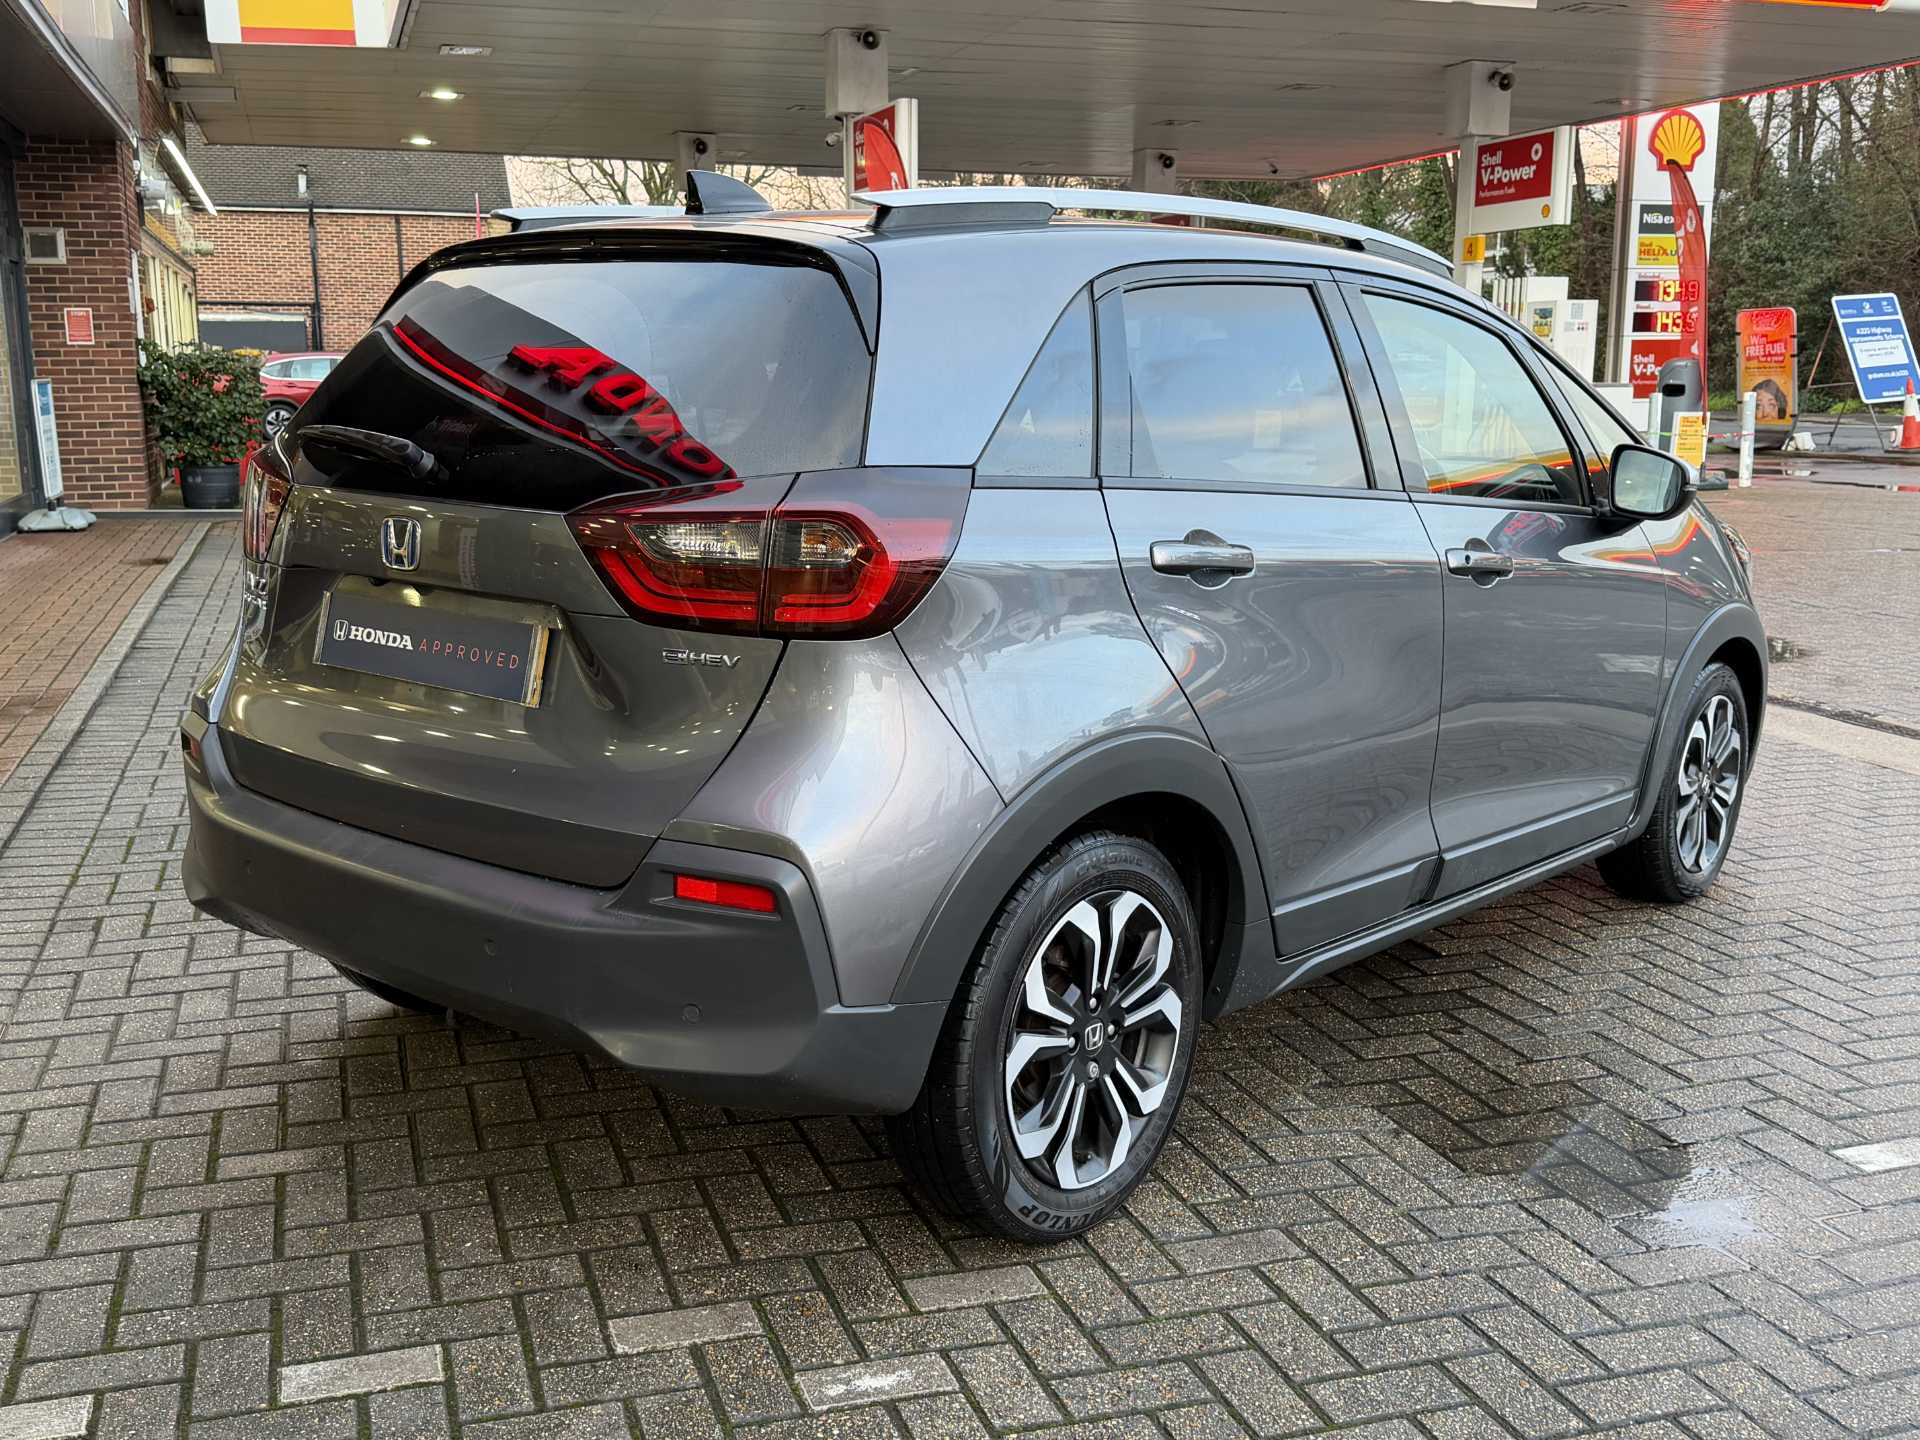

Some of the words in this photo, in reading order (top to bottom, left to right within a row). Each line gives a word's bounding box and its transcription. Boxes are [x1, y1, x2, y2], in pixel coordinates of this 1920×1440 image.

[1481, 151, 1502, 167] Shell
[1481, 163, 1537, 185] V-Power
[1643, 212, 1663, 224] Nisa
[1467, 242, 1473, 257] 4
[1639, 246, 1669, 257] HELIX
[1658, 280, 1700, 302] 134.9
[1750, 335, 1767, 346] Win
[1745, 345, 1765, 357] FREE
[1766, 343, 1786, 355] FUEL
[1633, 353, 1655, 364] Shell
[349, 625, 414, 651] HONDA
[418, 638, 519, 670] APPROVED
